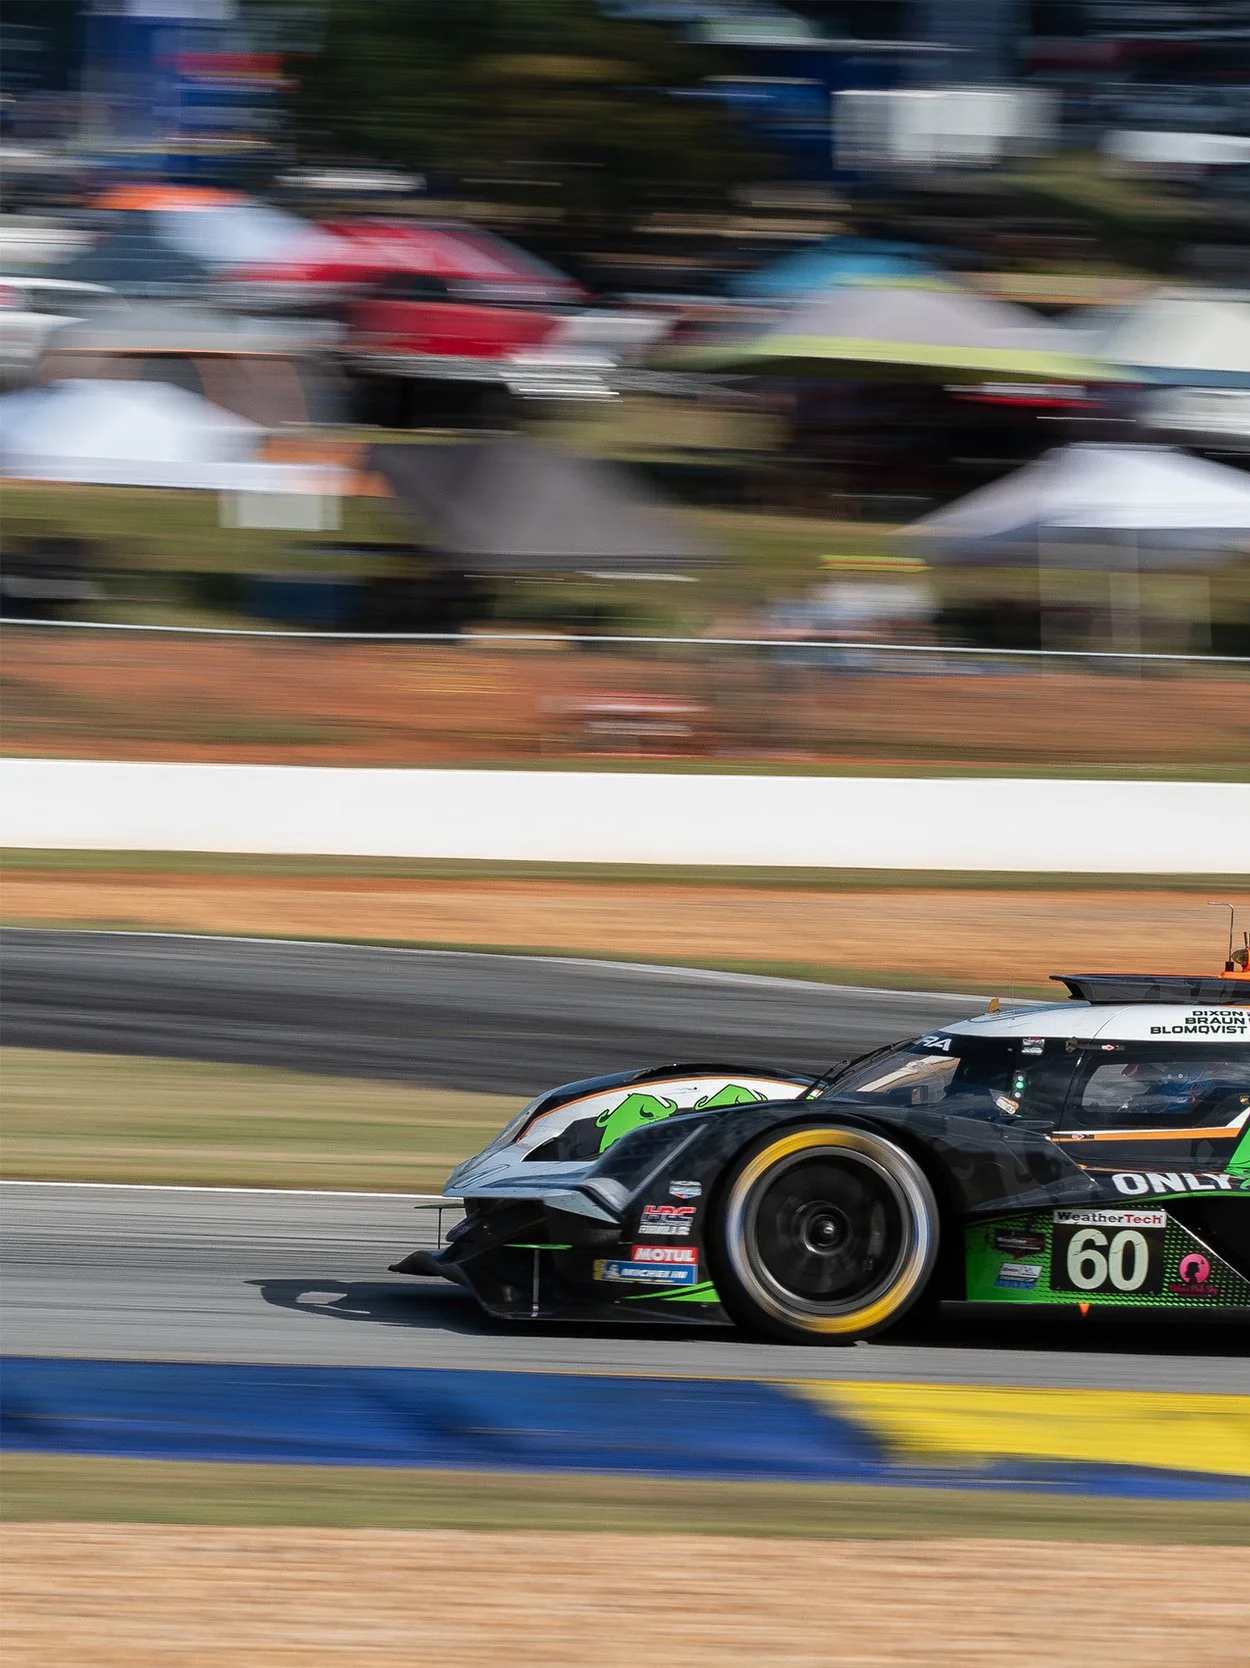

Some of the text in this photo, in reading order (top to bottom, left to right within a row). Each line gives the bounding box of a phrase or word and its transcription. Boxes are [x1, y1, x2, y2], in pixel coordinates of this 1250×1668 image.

[1184, 1017, 1246, 1025] BRAUN
[1150, 1025, 1248, 1034] BLOMQVIST
[1111, 1172, 1233, 1195] ONLY
[1056, 1210, 1163, 1225] WeatherTech
[633, 1247, 697, 1262] MOTUL
[1066, 1228, 1150, 1292] 60
